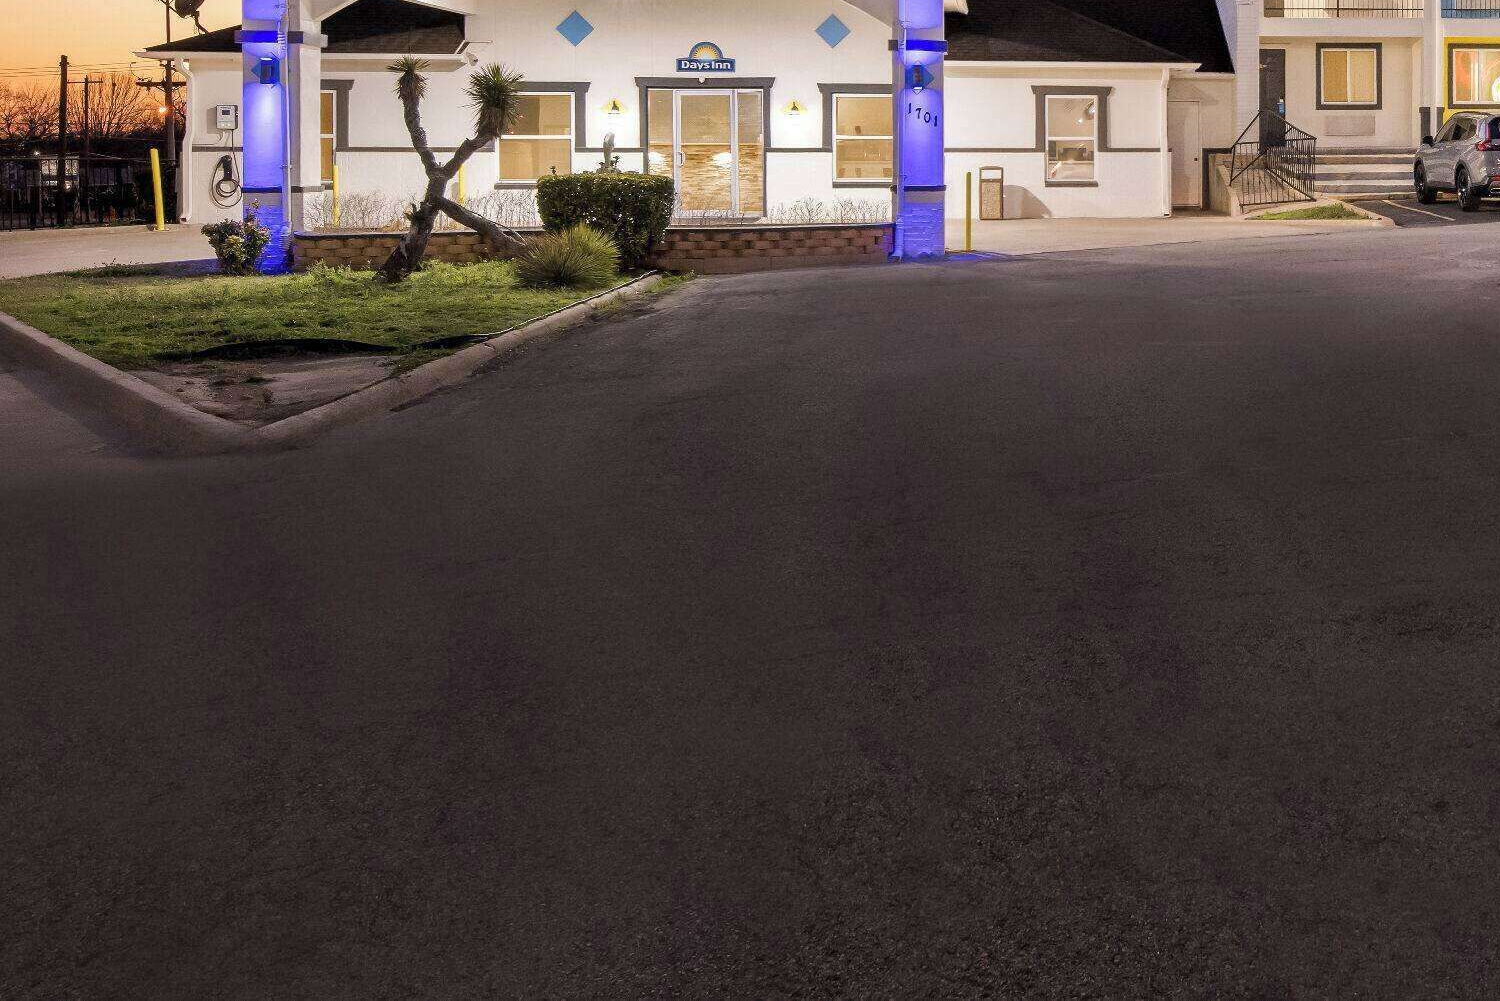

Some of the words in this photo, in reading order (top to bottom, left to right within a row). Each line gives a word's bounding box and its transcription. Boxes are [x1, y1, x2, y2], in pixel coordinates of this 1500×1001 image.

[681, 60, 710, 69] Days
[711, 60, 731, 69] Inn
[908, 102, 938, 127] 1701
